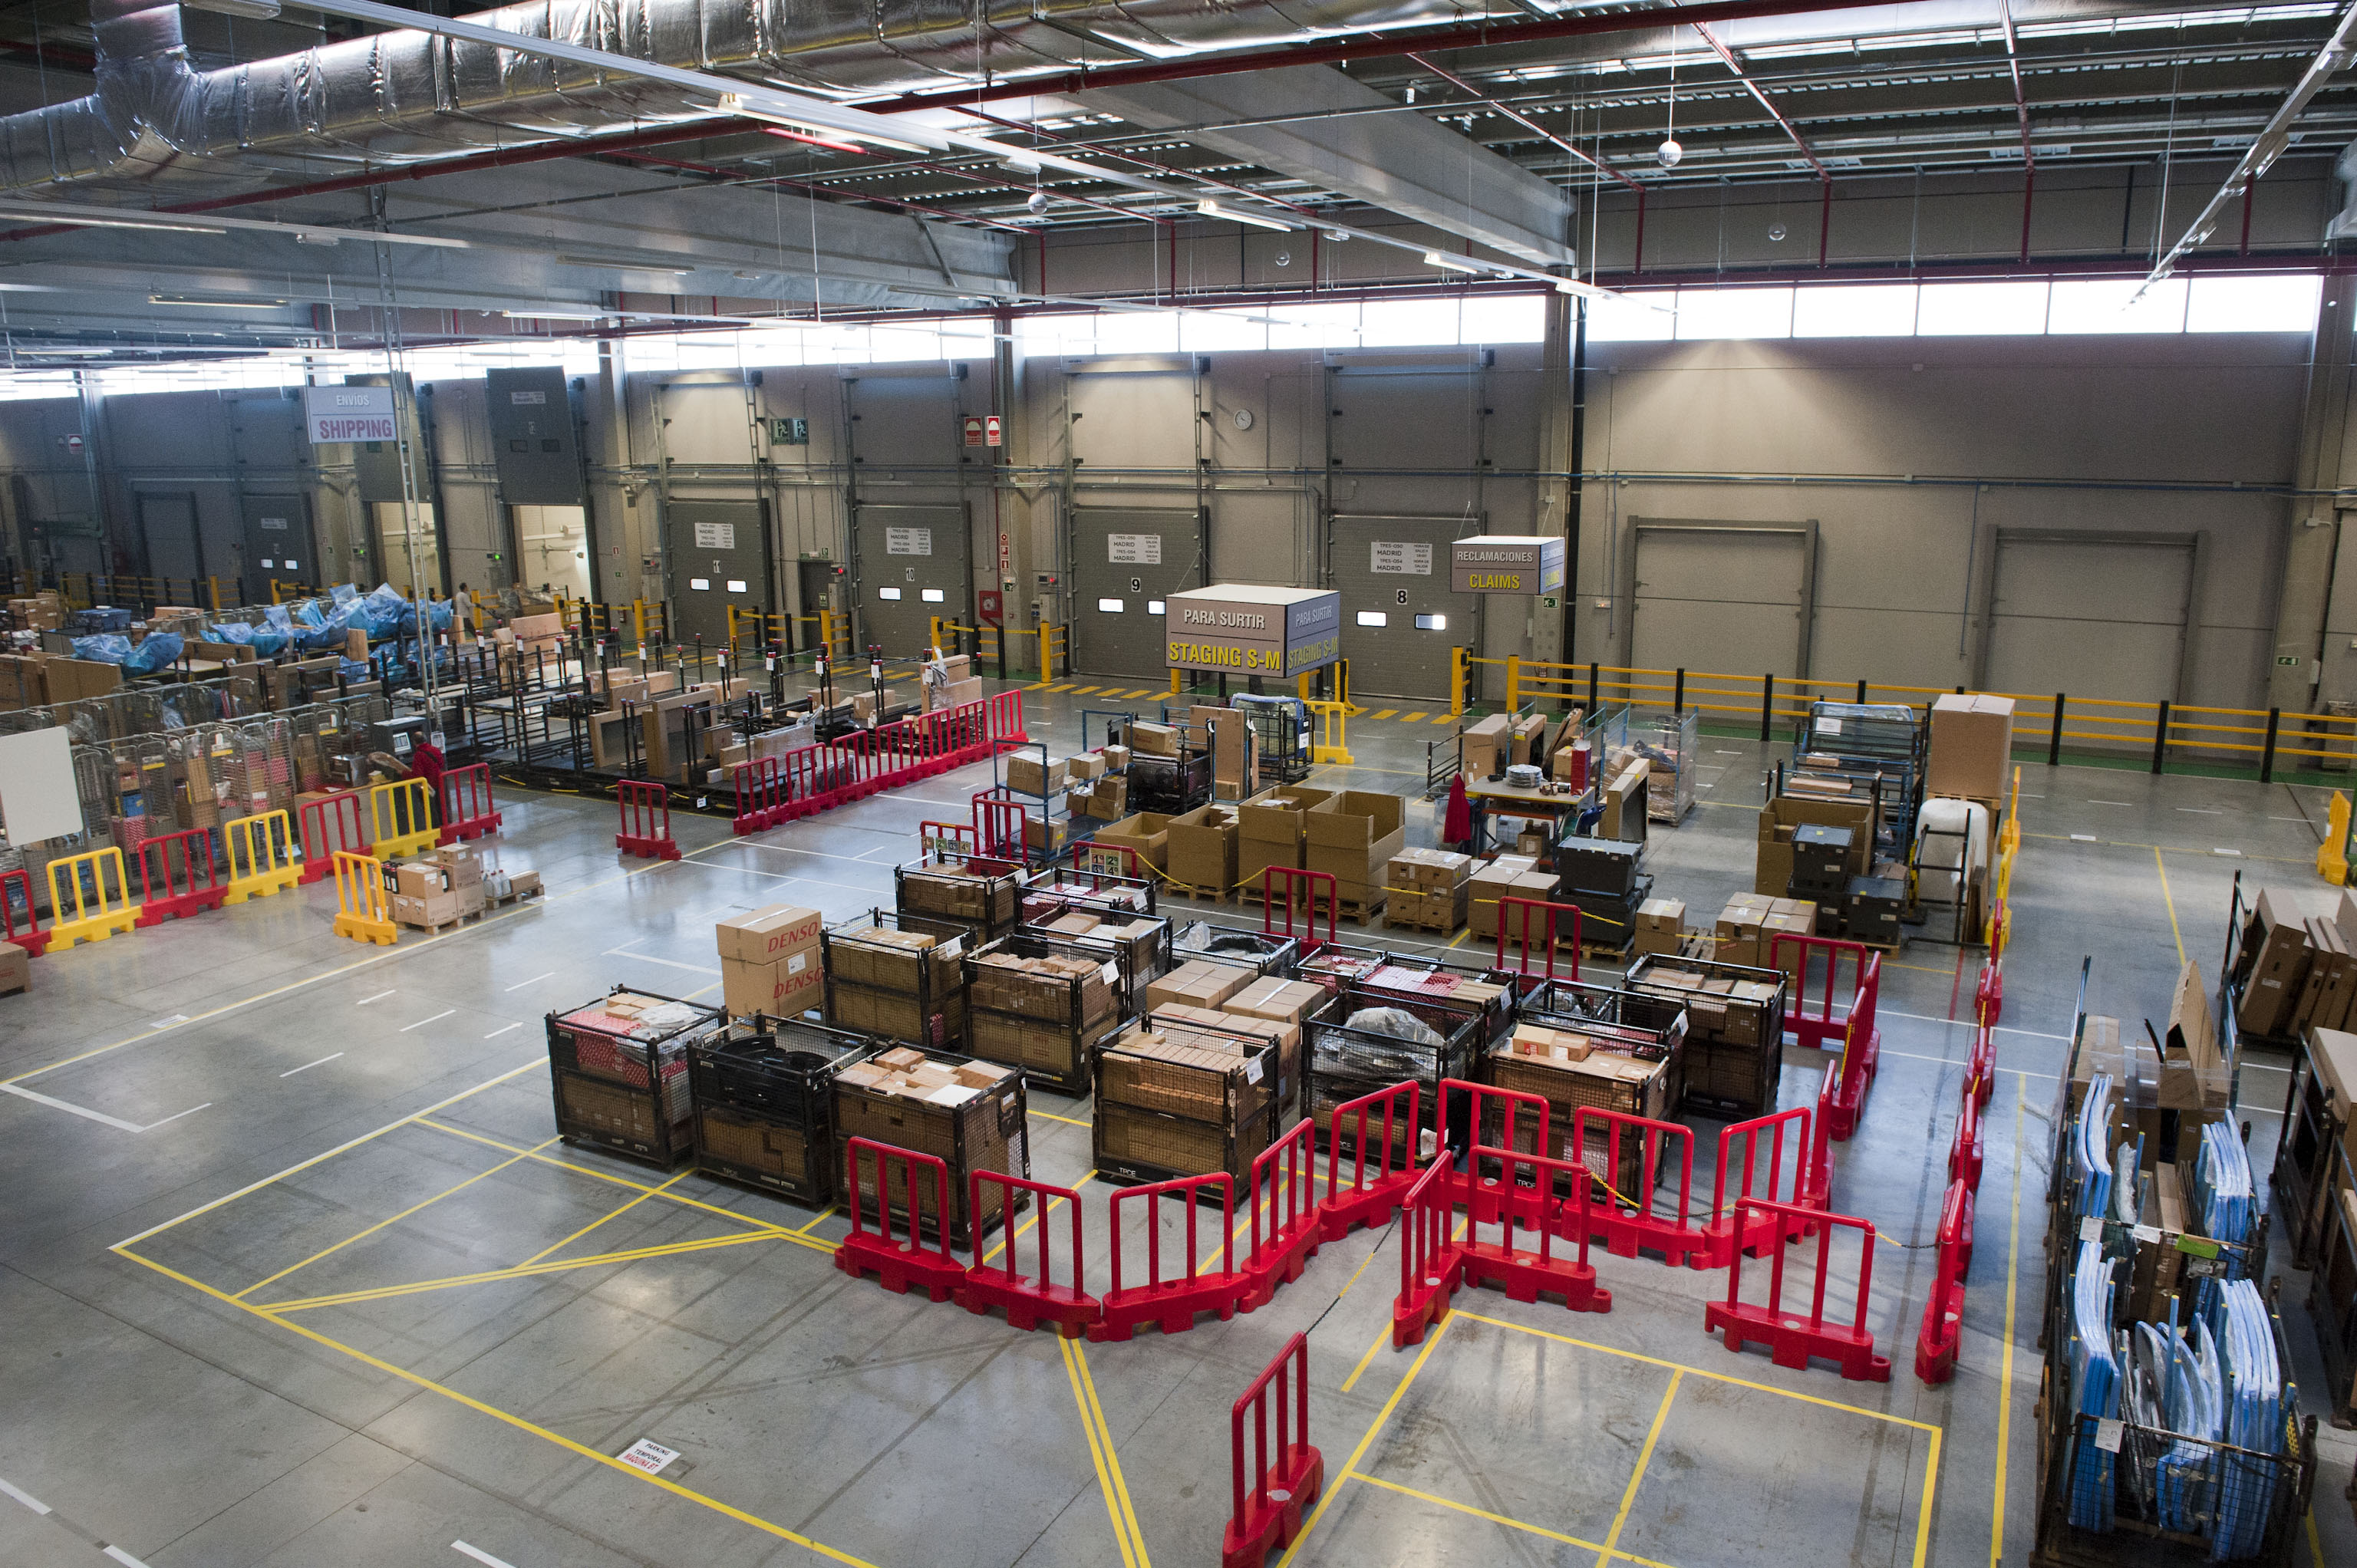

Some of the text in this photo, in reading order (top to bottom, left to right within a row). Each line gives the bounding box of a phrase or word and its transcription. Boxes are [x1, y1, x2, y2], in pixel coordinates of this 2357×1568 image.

[319, 419, 393, 440] SHIPPING
[1457, 551, 1533, 562] RECLAMACIONES
[907, 569, 914, 580] 10
[1469, 574, 1521, 589] CLAIMS
[1132, 578, 1140, 591] 9
[1397, 590, 1406, 604] 8
[1184, 608, 1266, 629] PARA SURTIR
[1295, 611, 1311, 628] PARA
[1169, 641, 1281, 670] STAGING S-M
[1288, 636, 1339, 670] STAGING S-M
[768, 921, 818, 953] DENSO
[773, 967, 823, 999] DENSO
[1119, 1167, 1136, 1178] TPCE
[634, 1448, 663, 1464] TEMPORAL
[644, 1443, 671, 1456] PARKING
